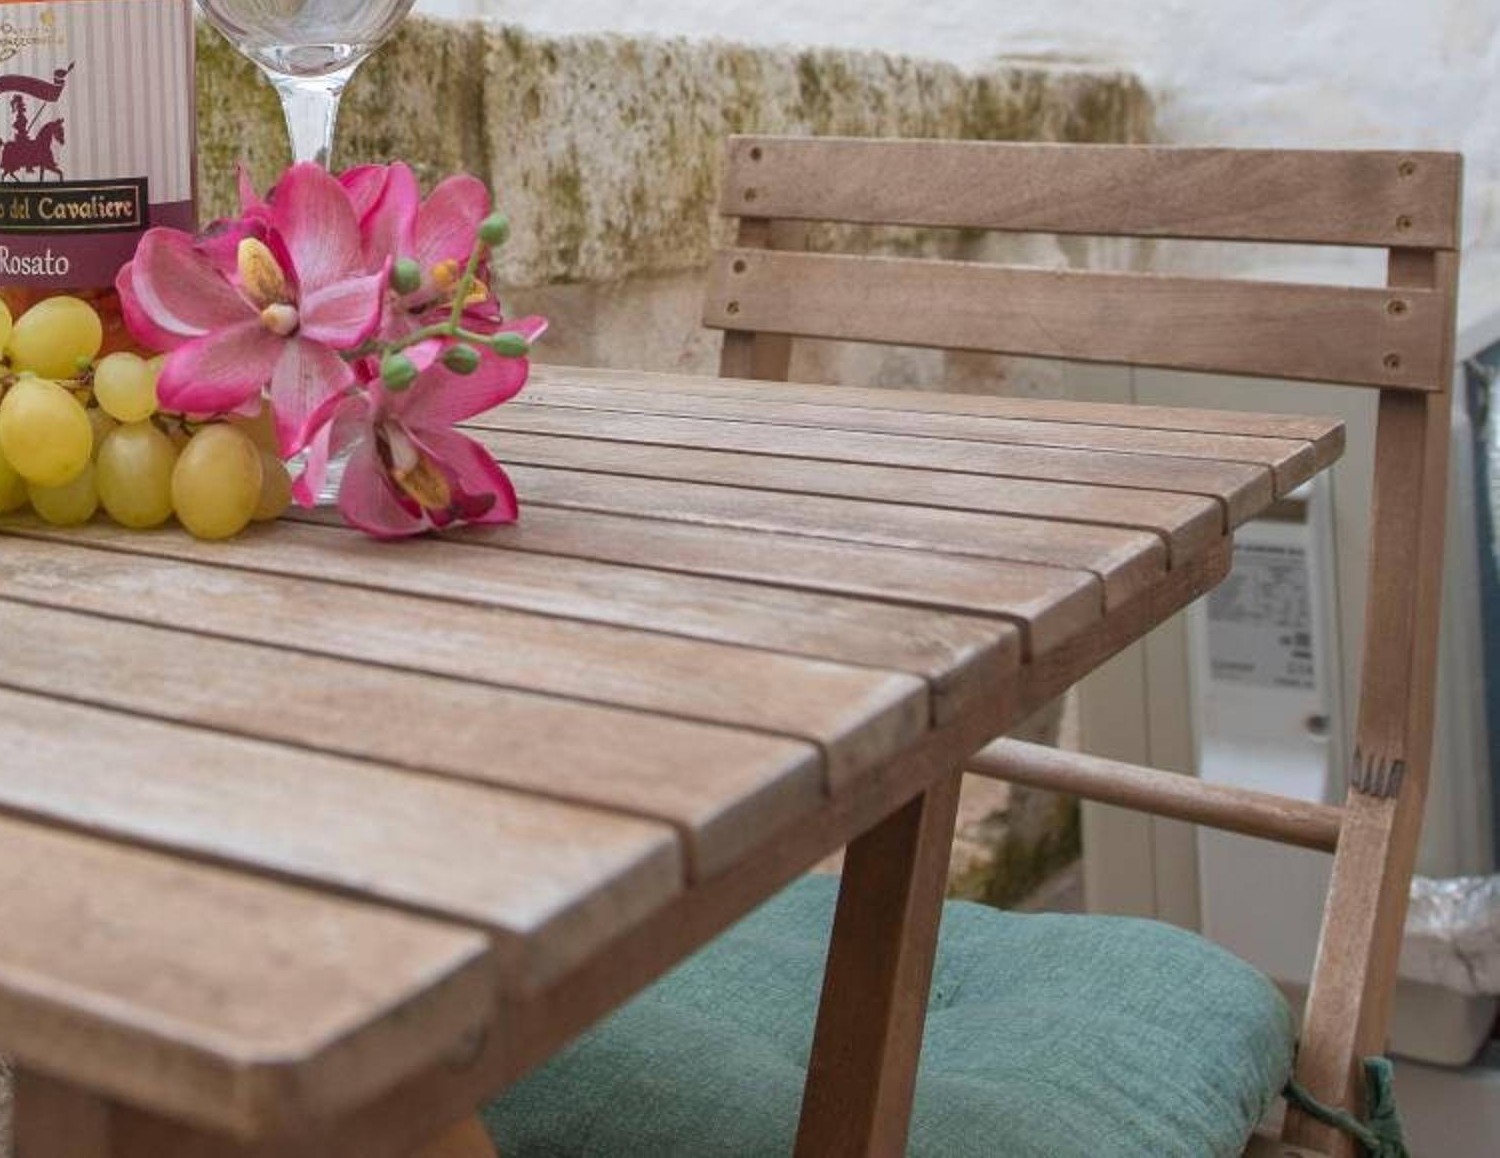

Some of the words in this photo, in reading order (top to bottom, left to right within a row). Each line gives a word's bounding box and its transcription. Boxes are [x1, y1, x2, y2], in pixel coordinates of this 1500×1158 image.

[10, 195, 31, 219] del
[38, 195, 133, 219] Cavaliere
[0, 245, 69, 275] Rosato
